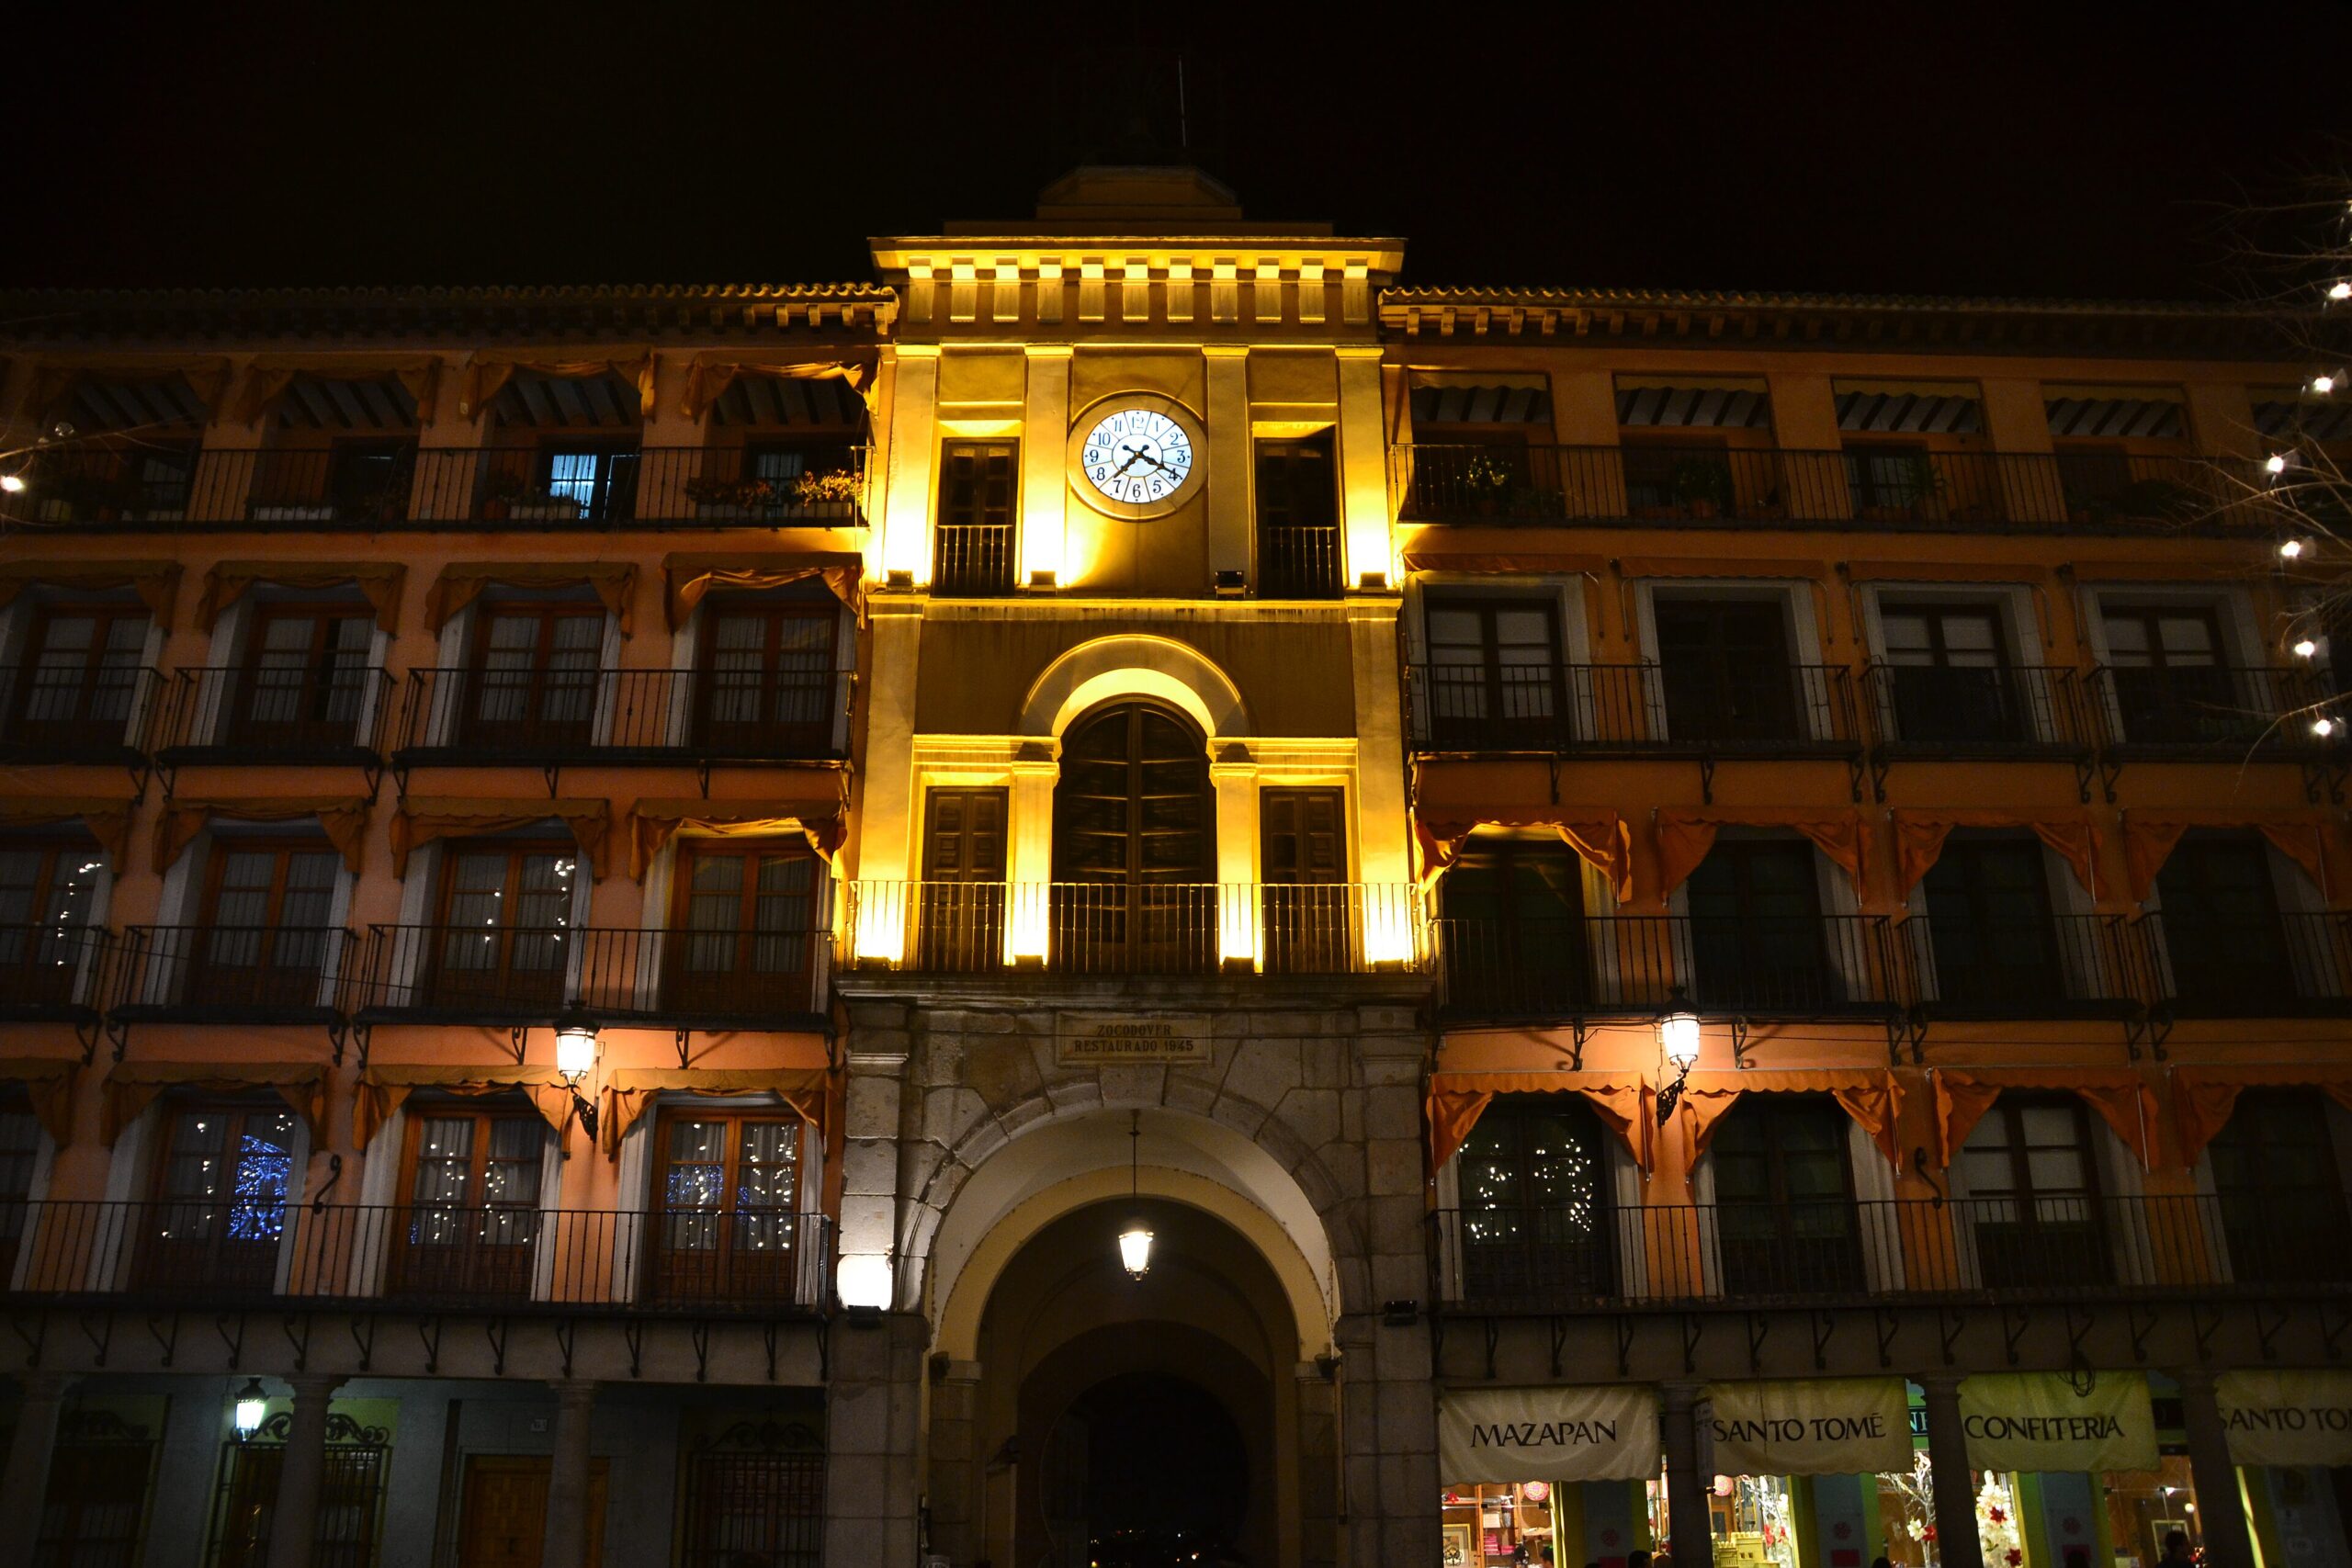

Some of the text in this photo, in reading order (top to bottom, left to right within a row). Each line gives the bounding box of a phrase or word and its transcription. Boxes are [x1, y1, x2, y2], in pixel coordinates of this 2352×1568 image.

[1114, 420, 1123, 433] 11
[1131, 415, 1145, 430] 12
[1098, 432, 1111, 446] 10
[1170, 432, 1179, 446] 2
[1090, 449, 1099, 463] 9
[1177, 450, 1186, 464] 3
[1096, 467, 1105, 481] 8
[1114, 479, 1122, 493] 7
[1132, 484, 1141, 499] 6
[1153, 479, 1162, 493] 5
[1097, 1024, 1171, 1037] ZOCODOVER
[1074, 1040, 1194, 1053] RESTAURADO 1945
[1471, 1419, 1617, 1449] MAZAPAN
[1712, 1417, 1804, 1443] SANTO
[1809, 1412, 1886, 1441] TOMÉ
[1963, 1415, 2125, 1441] CONFITERIA
